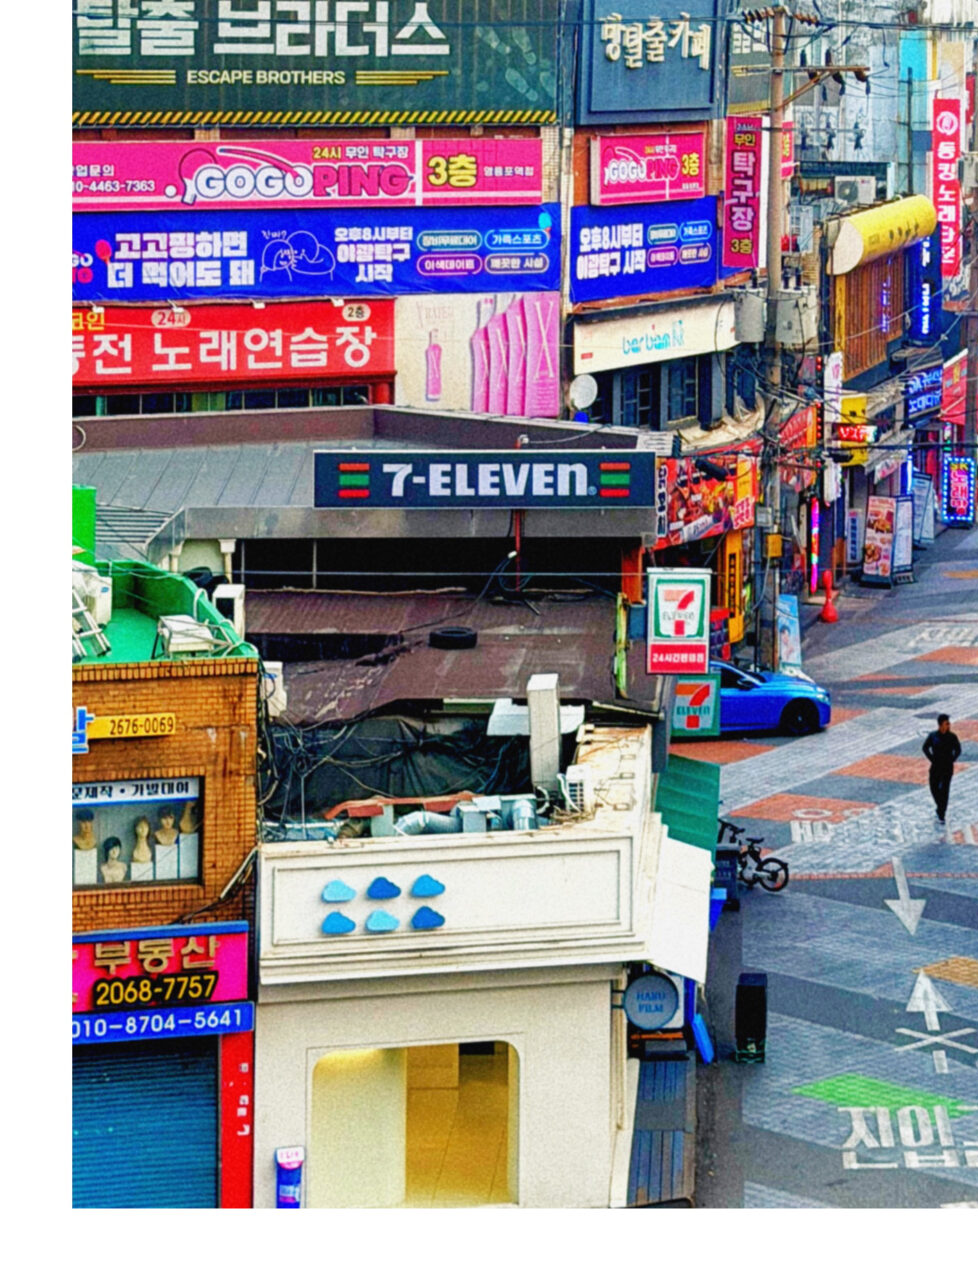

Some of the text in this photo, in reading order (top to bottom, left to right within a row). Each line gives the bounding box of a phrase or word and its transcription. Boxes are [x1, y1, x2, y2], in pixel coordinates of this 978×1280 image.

[213, 0, 450, 57] 브라더스
[187, 69, 346, 85] ESCAPE BROTHERS
[734, 133, 756, 147] 무인
[313, 146, 409, 159] 24시 무인 탁구장
[72, 164, 114, 177] 업문의
[427, 154, 478, 187] 3층
[681, 153, 700, 176] 3층
[731, 152, 756, 232] 탁구장
[114, 231, 248, 260] 고고핑하면
[334, 227, 414, 242] 오후8시부터
[491, 234, 542, 245] 가족스포츠
[579, 223, 644, 252] 오후8시부터
[731, 236, 753, 254] 3층
[336, 243, 411, 263] 야광탁구
[576, 248, 646, 280] 야광탁구 시작
[107, 261, 134, 288] 더
[142, 260, 222, 287] 먹어도
[355, 263, 393, 283] 시작
[424, 259, 475, 271] 이색데이트
[347, 305, 365, 319] 2층
[152, 325, 377, 372] 노래연습장
[662, 589, 695, 636] 7
[675, 683, 711, 729] 7
[109, 716, 174, 736] 2676-0069
[94, 936, 219, 974] 부동산
[95, 975, 217, 1006] 2068-7757
